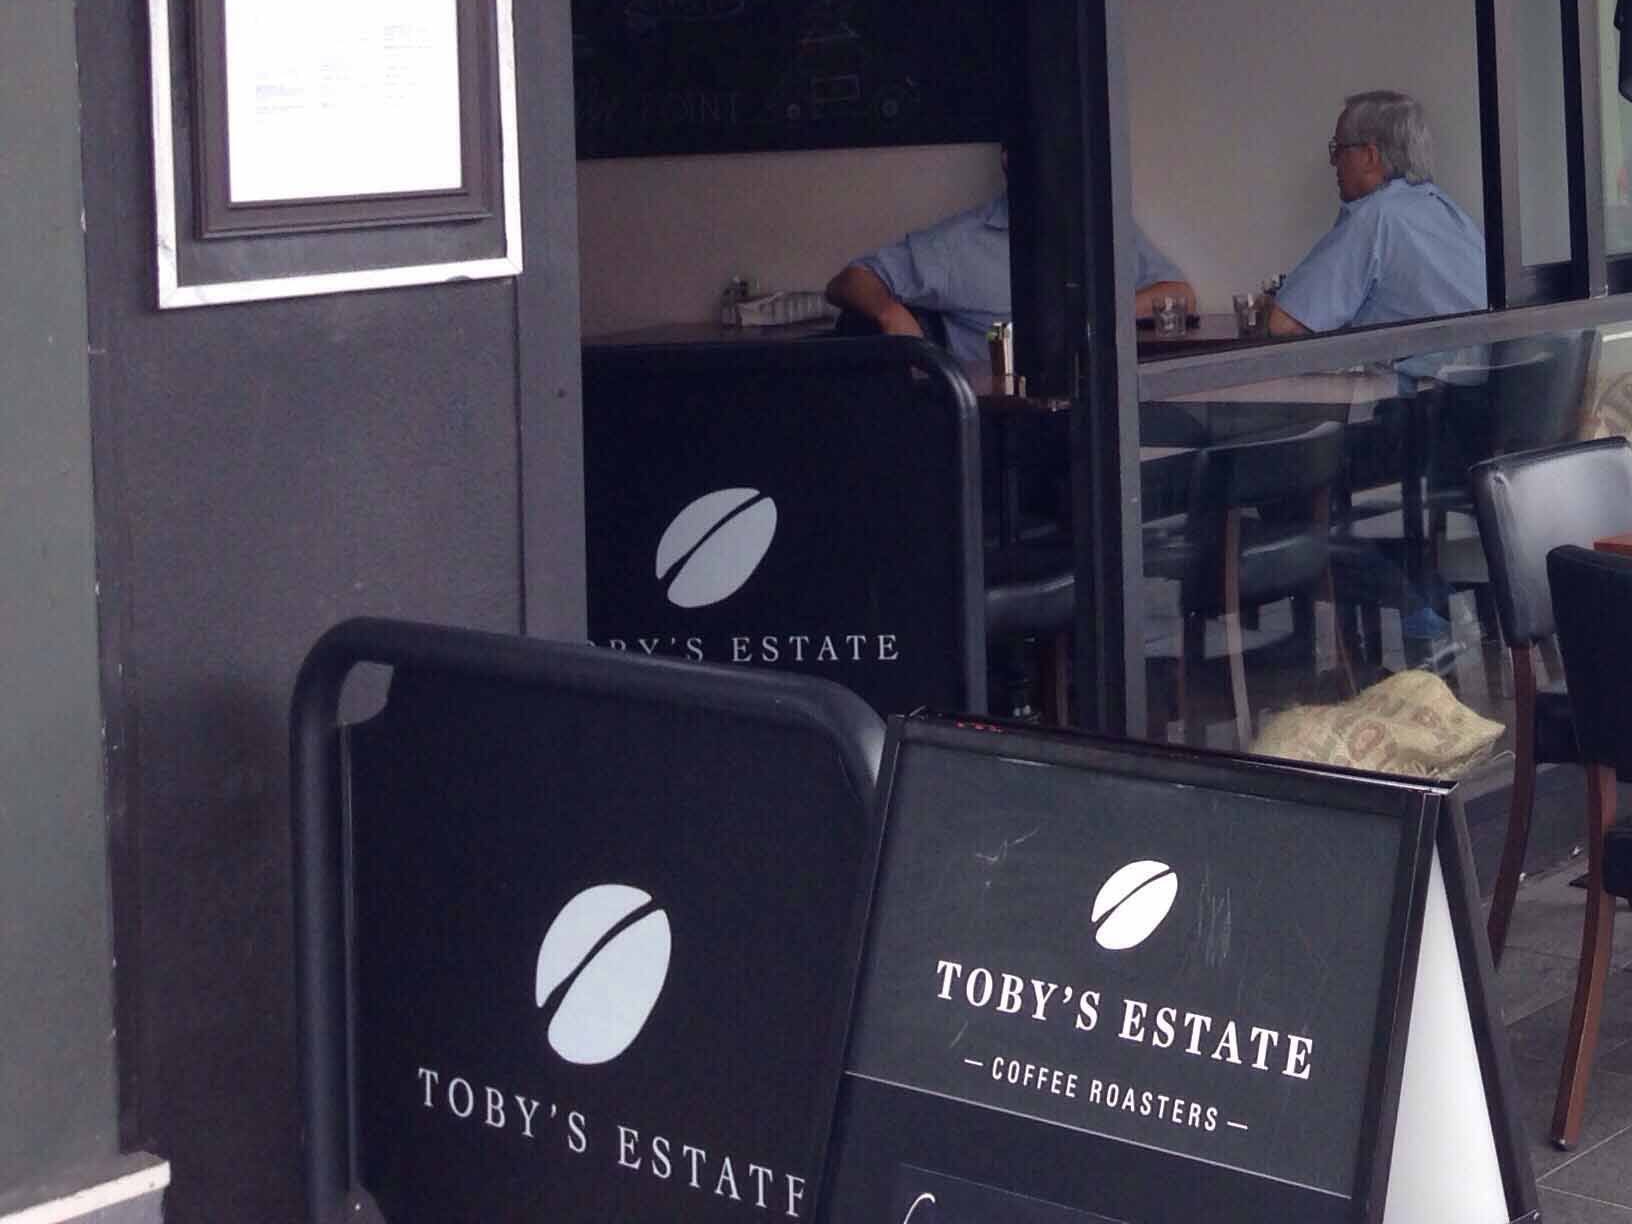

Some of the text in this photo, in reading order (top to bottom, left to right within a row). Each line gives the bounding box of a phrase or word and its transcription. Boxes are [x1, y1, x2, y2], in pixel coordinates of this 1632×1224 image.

[731, 632, 900, 662] ESTATE
[937, 959, 1314, 1081] TOBY'S ESTATE
[417, 1067, 807, 1218] TOBY'S ESTATE
[991, 1055, 1219, 1132] COFFEE ROASTERS
